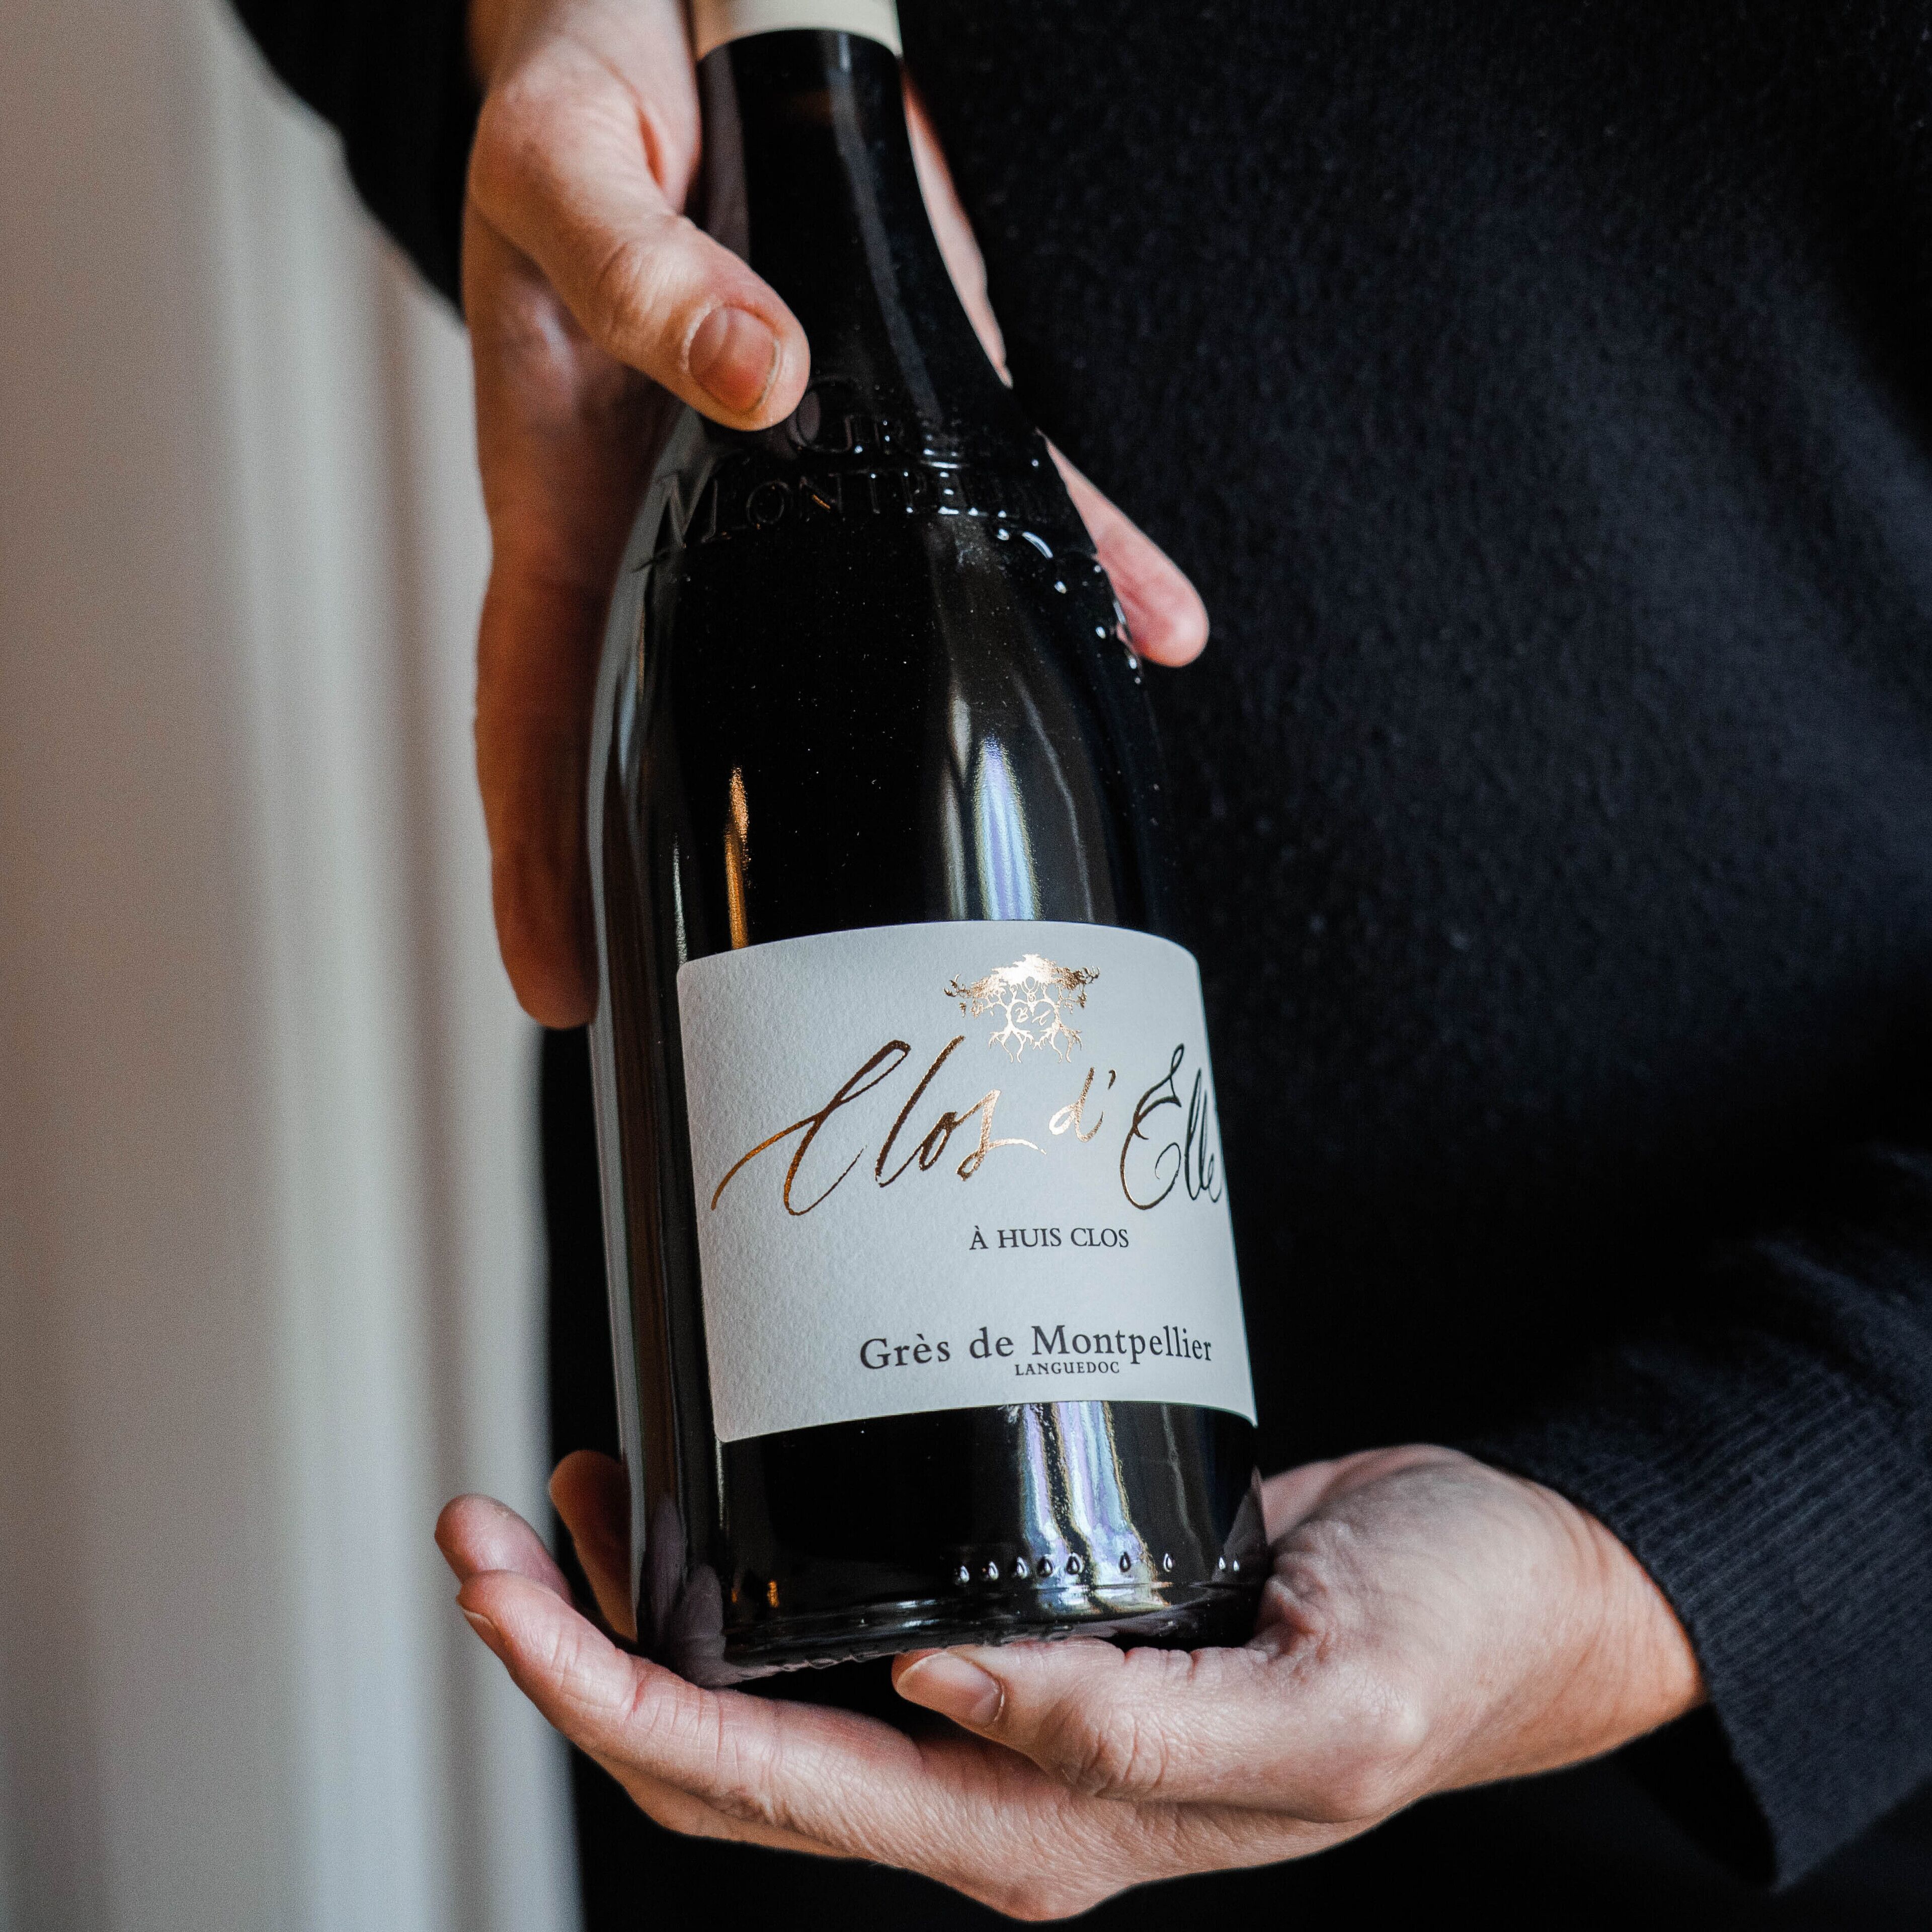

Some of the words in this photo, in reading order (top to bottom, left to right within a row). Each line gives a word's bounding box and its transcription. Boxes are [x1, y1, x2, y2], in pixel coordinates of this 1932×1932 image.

[710, 1035, 1046, 1216] Clos
[969, 1225, 989, 1250] À
[997, 1228, 1062, 1248] HUIS
[1071, 1228, 1129, 1248] CLOS
[859, 1334, 951, 1370] Grès
[969, 1326, 1014, 1358] de
[1031, 1324, 1212, 1364] Montpellier
[1015, 1361, 1120, 1376] LANGUEDOC
